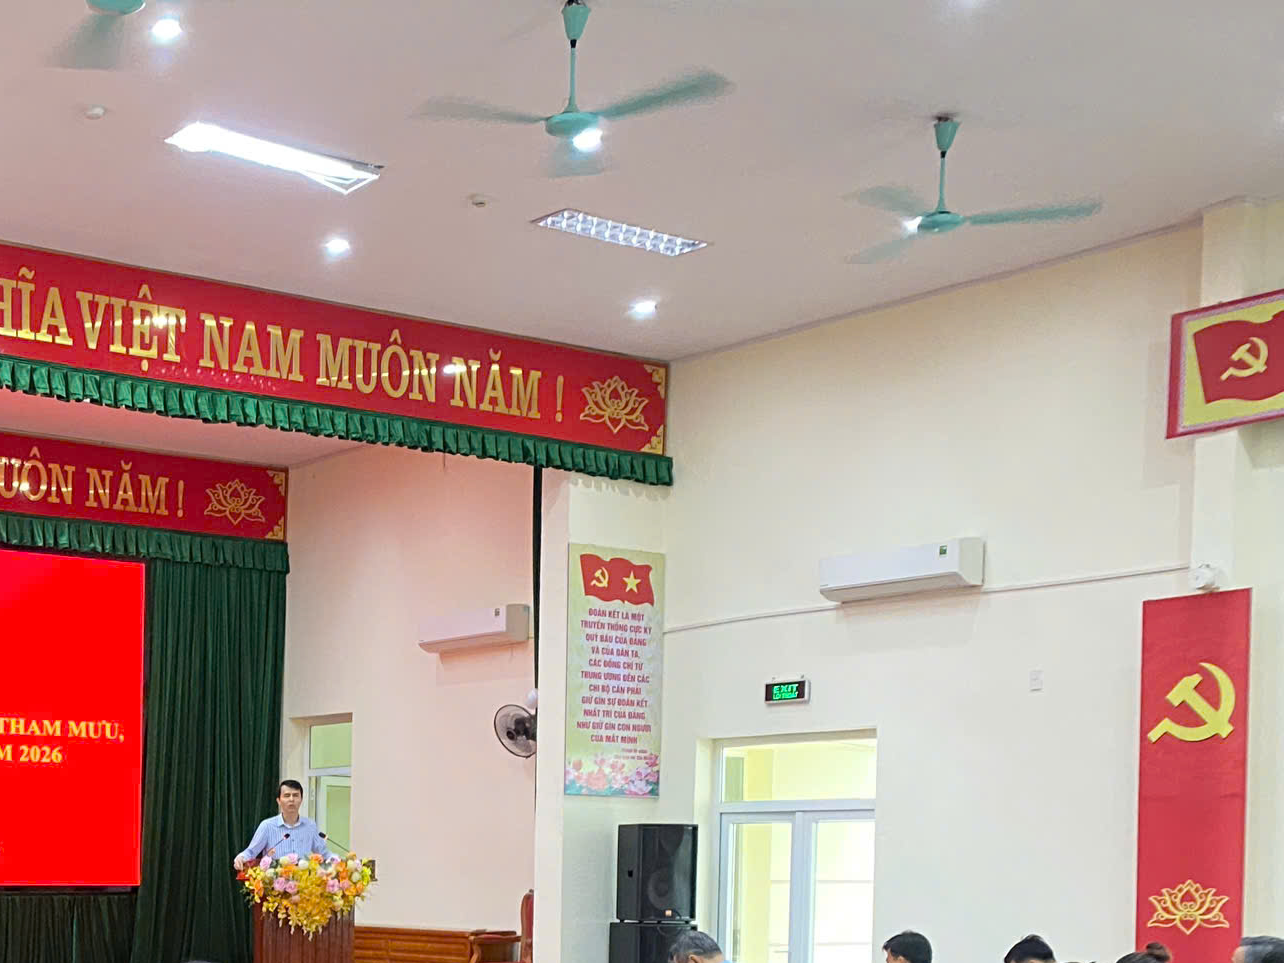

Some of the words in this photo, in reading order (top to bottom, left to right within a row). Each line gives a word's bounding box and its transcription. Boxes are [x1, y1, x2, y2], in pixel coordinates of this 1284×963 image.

[75, 285, 187, 372] VIỆT
[198, 312, 306, 383] NAM
[315, 328, 440, 404] MUÔN
[67, 719, 124, 743] MƯU,
[19, 744, 63, 763] 2026
